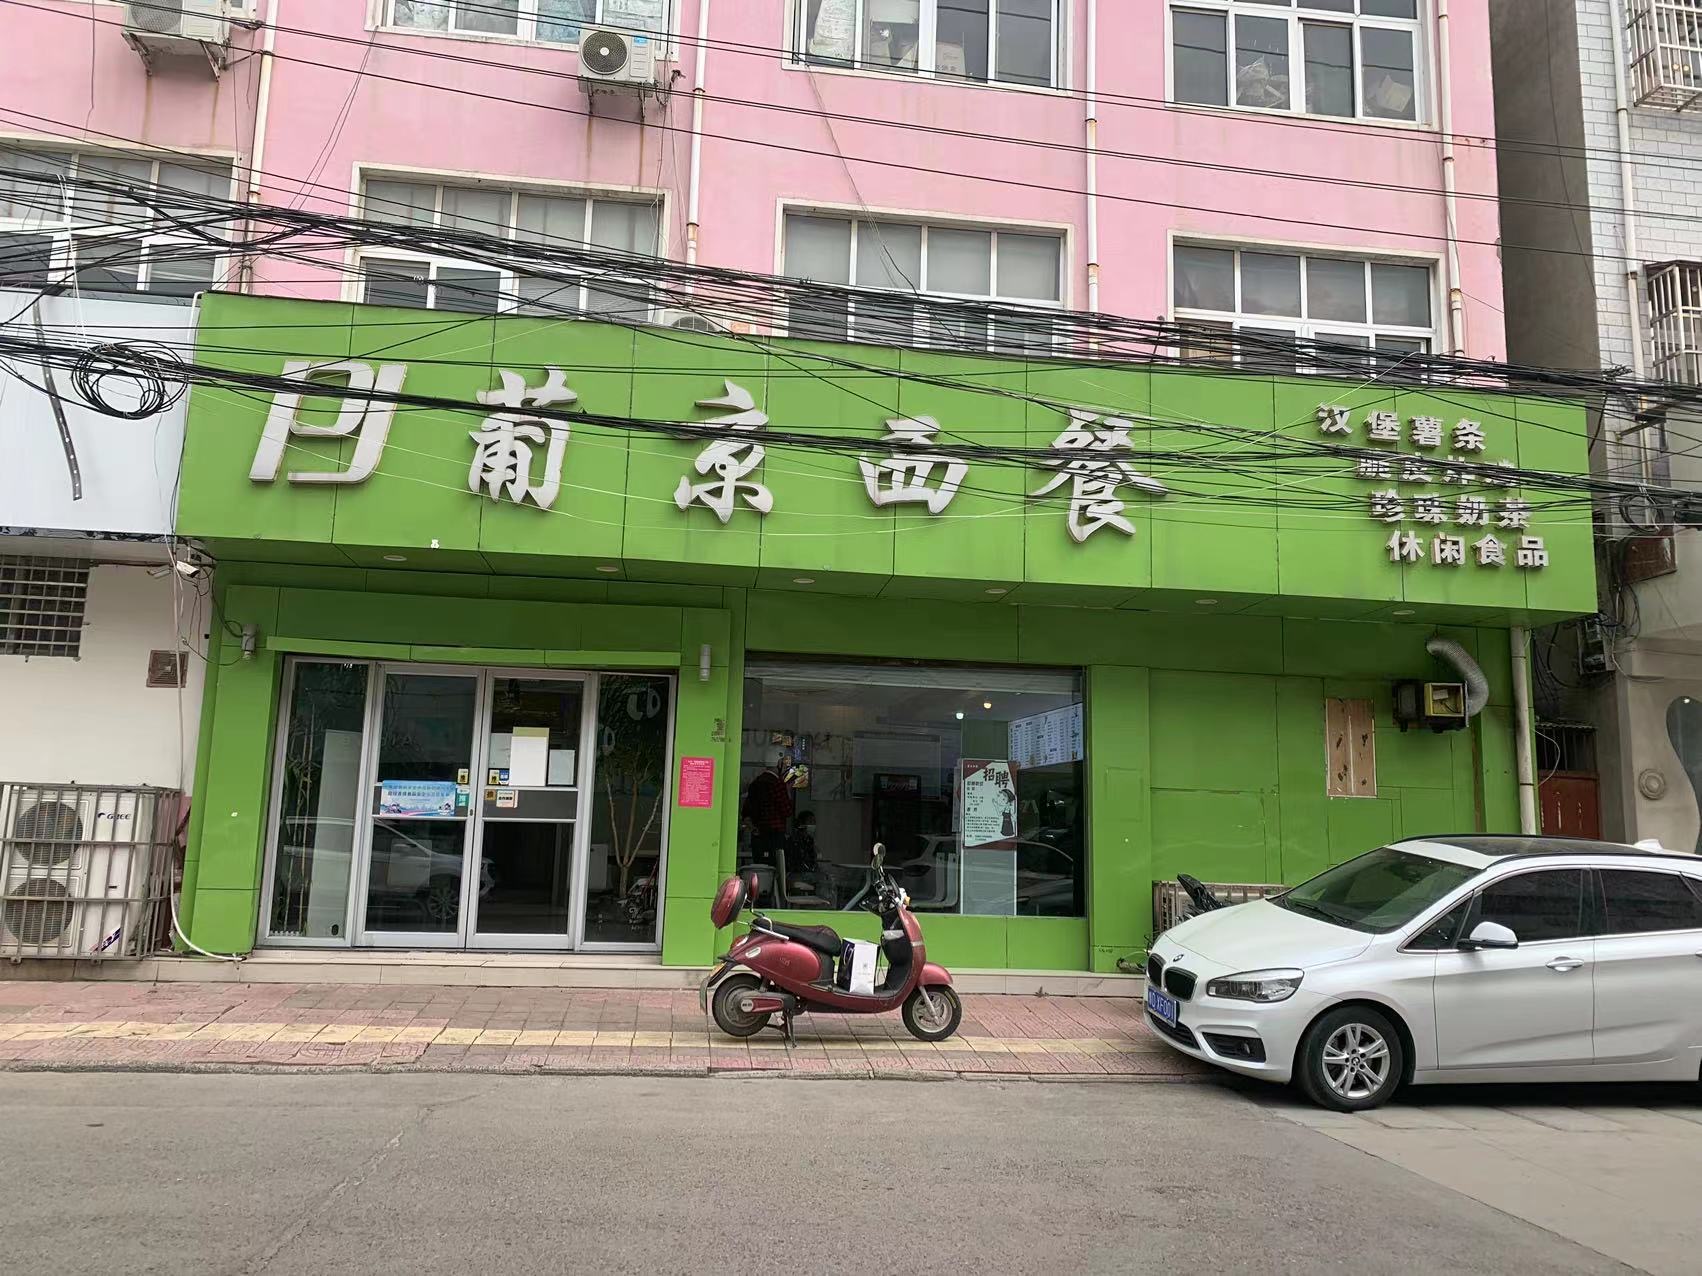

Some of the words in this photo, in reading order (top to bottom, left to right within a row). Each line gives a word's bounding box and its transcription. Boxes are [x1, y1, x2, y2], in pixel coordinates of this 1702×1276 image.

[1316, 402, 1487, 453] 汉堡薯条
[1370, 488, 1531, 529] 珍珠奶茶
[1385, 530, 1549, 568] 休闲食品
[983, 768, 1009, 789] 招聘
